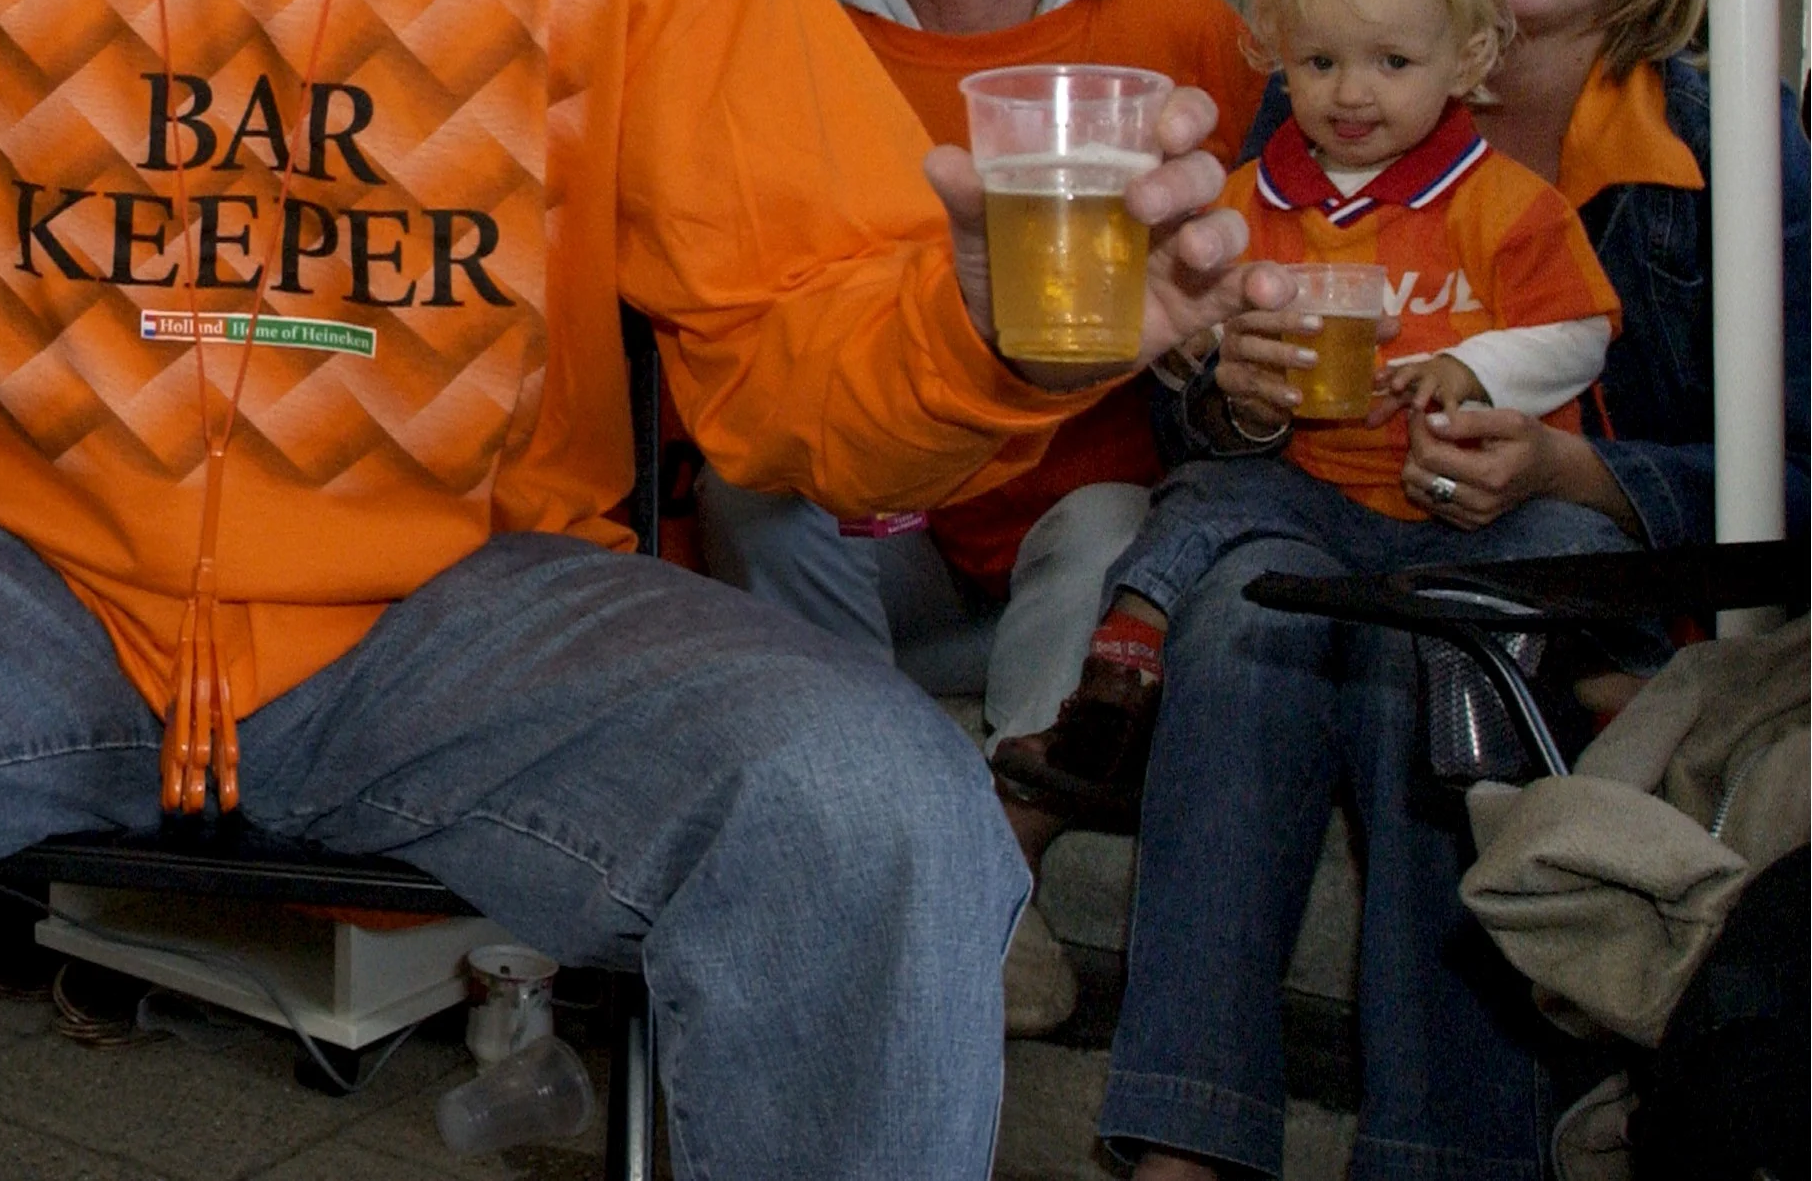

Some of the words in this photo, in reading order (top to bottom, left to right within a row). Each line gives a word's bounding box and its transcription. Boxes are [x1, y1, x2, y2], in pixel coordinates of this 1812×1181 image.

[137, 72, 387, 185] BAR
[11, 179, 515, 307] KEEPER
[281, 325, 298, 340] of
[302, 326, 370, 350] Heineken
